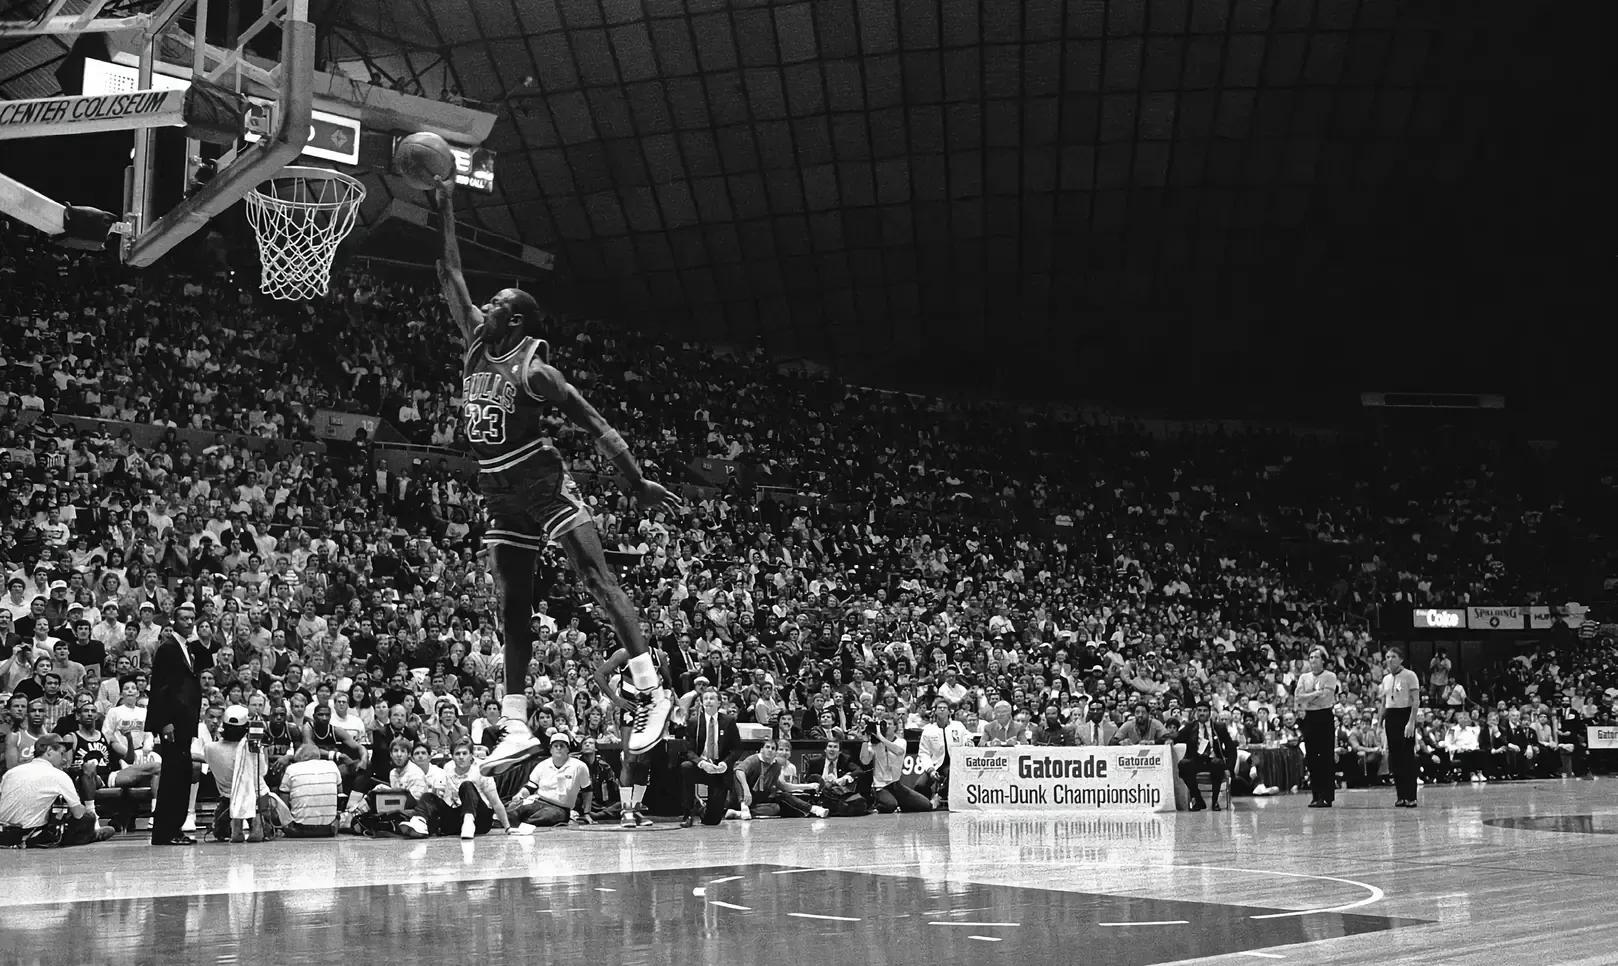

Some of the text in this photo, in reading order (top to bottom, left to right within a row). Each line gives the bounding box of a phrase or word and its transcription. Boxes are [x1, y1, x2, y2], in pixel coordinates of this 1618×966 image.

[0, 92, 168, 125] CENTER COLISEUM
[465, 403, 506, 444] 23
[1426, 608, 1459, 628] Coke
[966, 756, 1008, 767] Gatorade
[1018, 755, 1107, 779] Gatorade
[1118, 756, 1161, 766] Gatorade
[966, 783, 1161, 808] Slam-Dunk Championship
